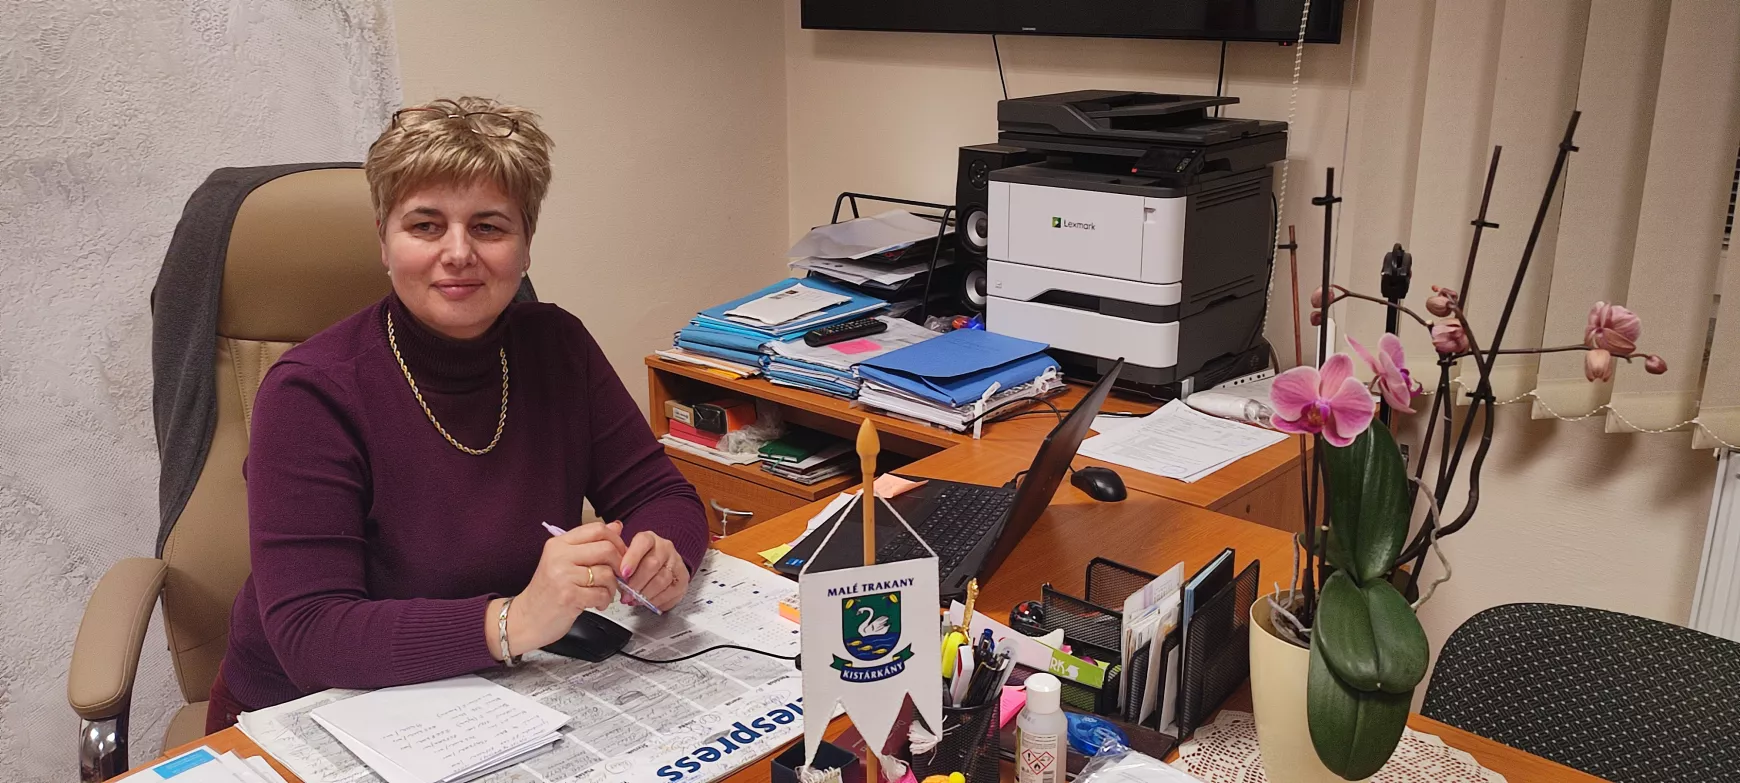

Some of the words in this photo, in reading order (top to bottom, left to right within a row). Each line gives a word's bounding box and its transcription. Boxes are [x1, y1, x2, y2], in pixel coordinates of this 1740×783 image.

[1063, 219, 1096, 231] Lexmark
[827, 583, 859, 597] MALÉ
[862, 578, 915, 593] TRAKANY
[842, 661, 903, 680] KISTÁRKÁNY
